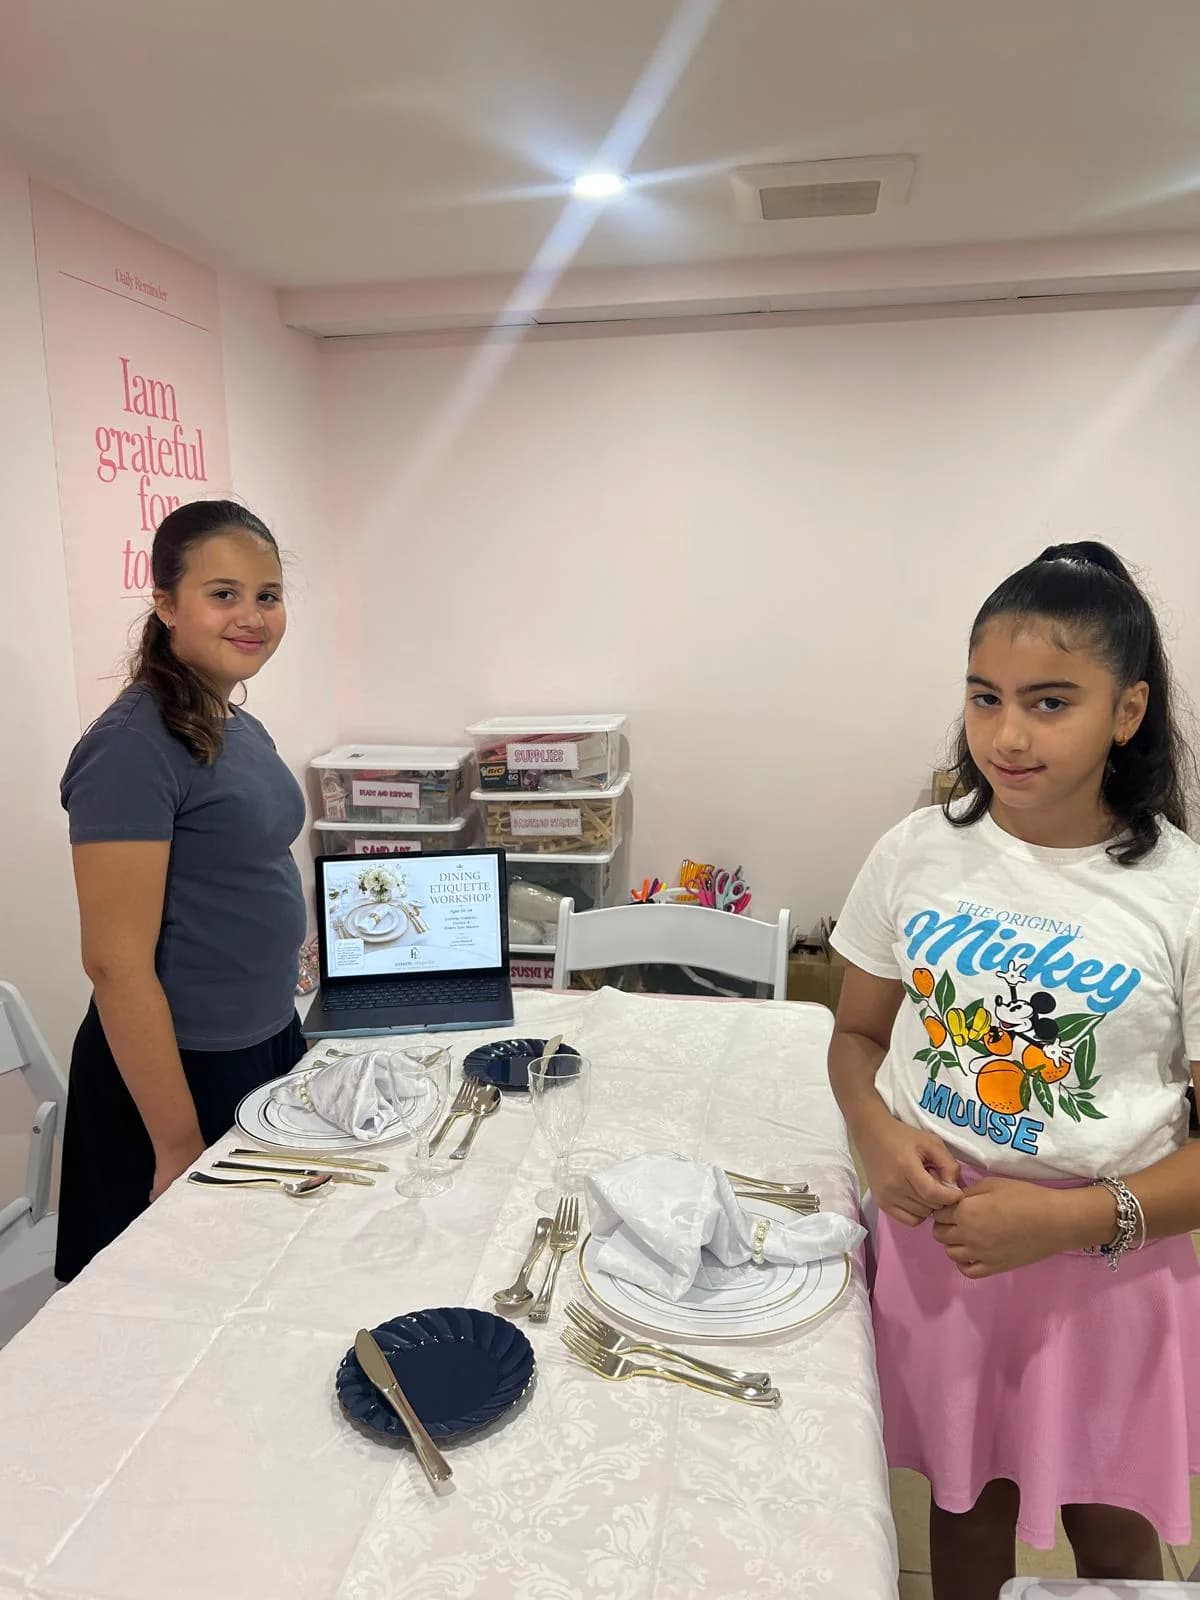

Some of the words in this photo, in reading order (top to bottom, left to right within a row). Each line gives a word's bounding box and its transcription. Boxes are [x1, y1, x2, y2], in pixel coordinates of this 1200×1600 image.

[96, 424, 208, 483] grateful
[122, 539, 156, 590] to
[514, 749, 564, 763] SUPPLIES
[377, 790, 389, 798] AND
[439, 871, 481, 881] DINING
[430, 881, 491, 895] ETIQUETTE
[430, 893, 491, 904] WORKSHOP
[956, 900, 994, 918] THE
[996, 911, 1084, 940] ORIGINAL
[903, 909, 1143, 1014] Mickey
[510, 966, 542, 978] SUSHI
[919, 1077, 1044, 1156] MOUSE
